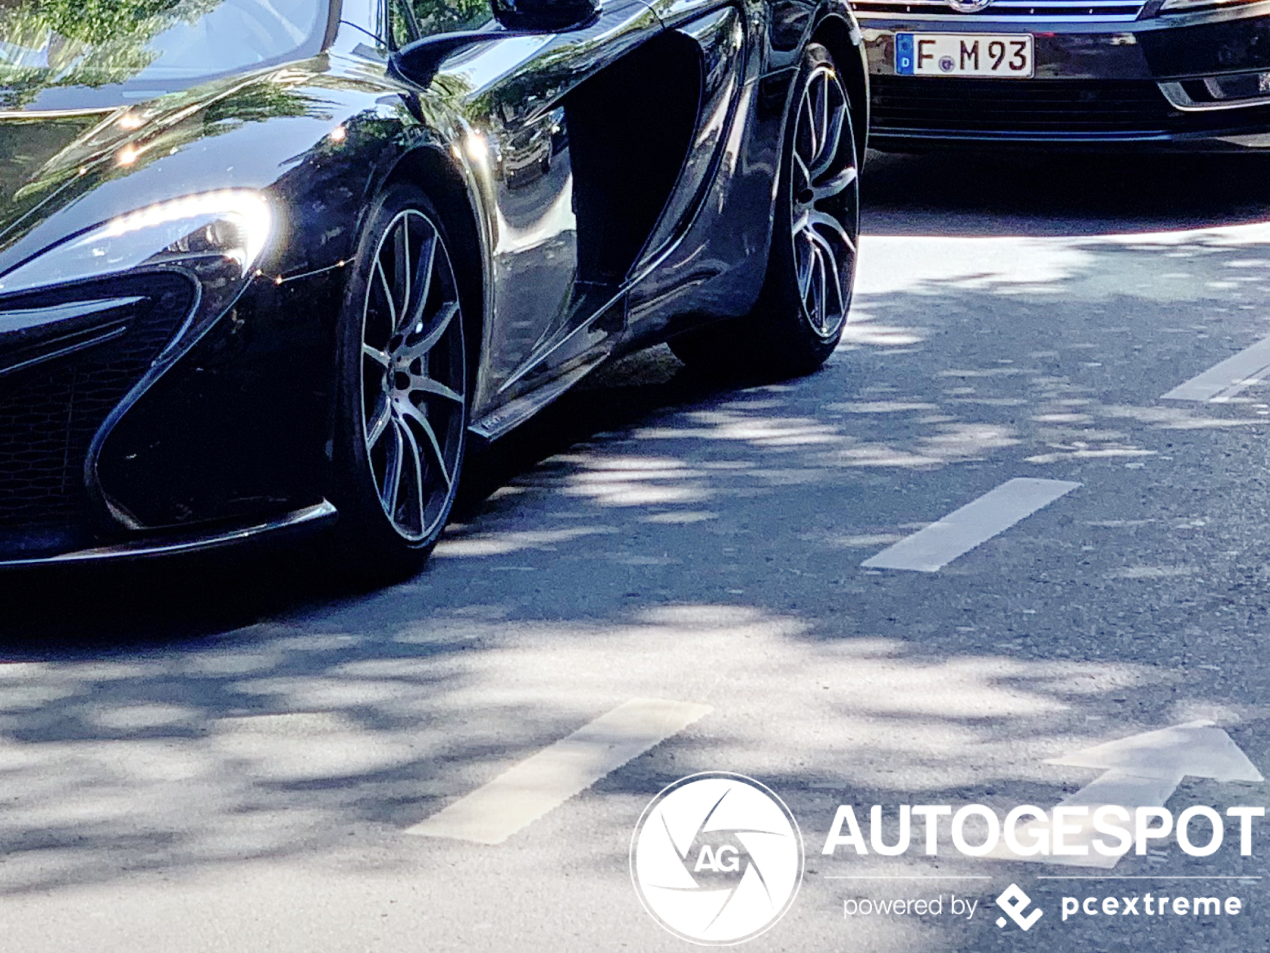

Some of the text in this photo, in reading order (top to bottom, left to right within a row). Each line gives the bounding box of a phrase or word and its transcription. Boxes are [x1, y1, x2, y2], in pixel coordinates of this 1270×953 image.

[901, 39, 1027, 71] D F M 93
